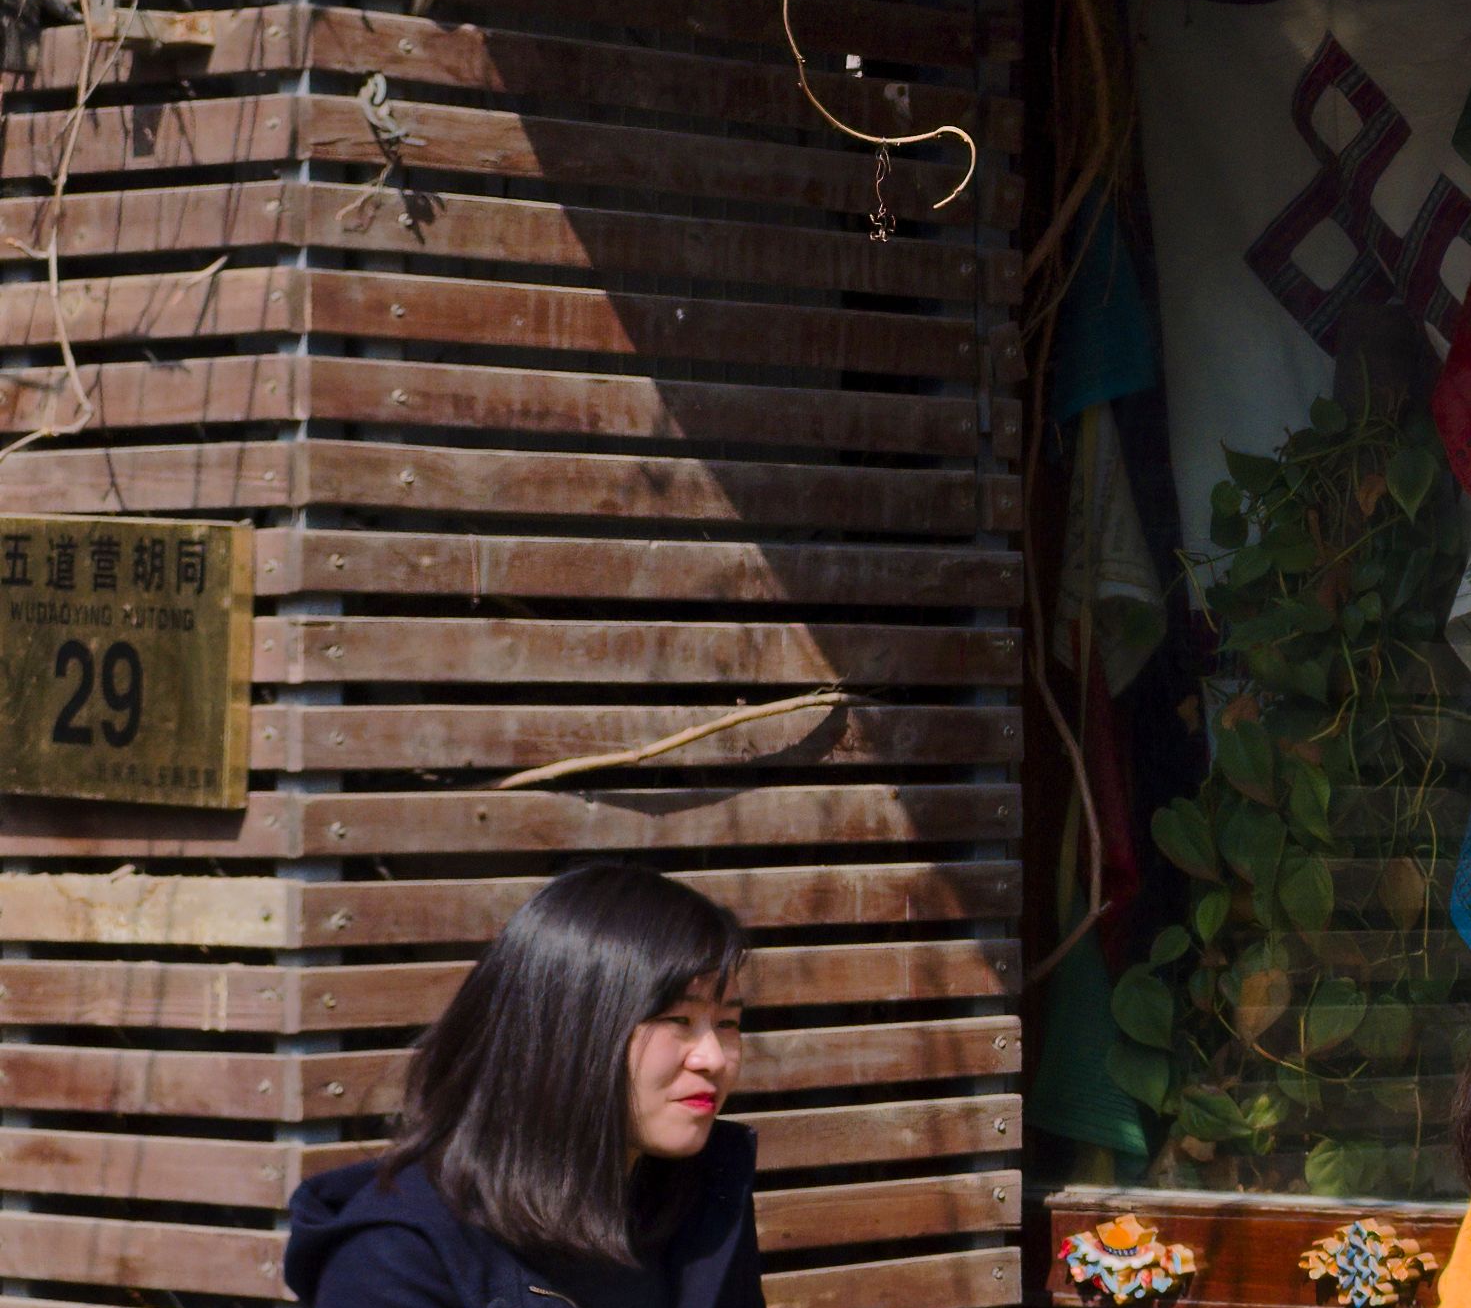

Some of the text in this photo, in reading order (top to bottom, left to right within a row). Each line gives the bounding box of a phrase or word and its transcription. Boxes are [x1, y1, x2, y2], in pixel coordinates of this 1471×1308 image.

[2, 533, 208, 594] 五道营胡同
[10, 599, 113, 627] WUDAOYING
[52, 638, 144, 747] 29
